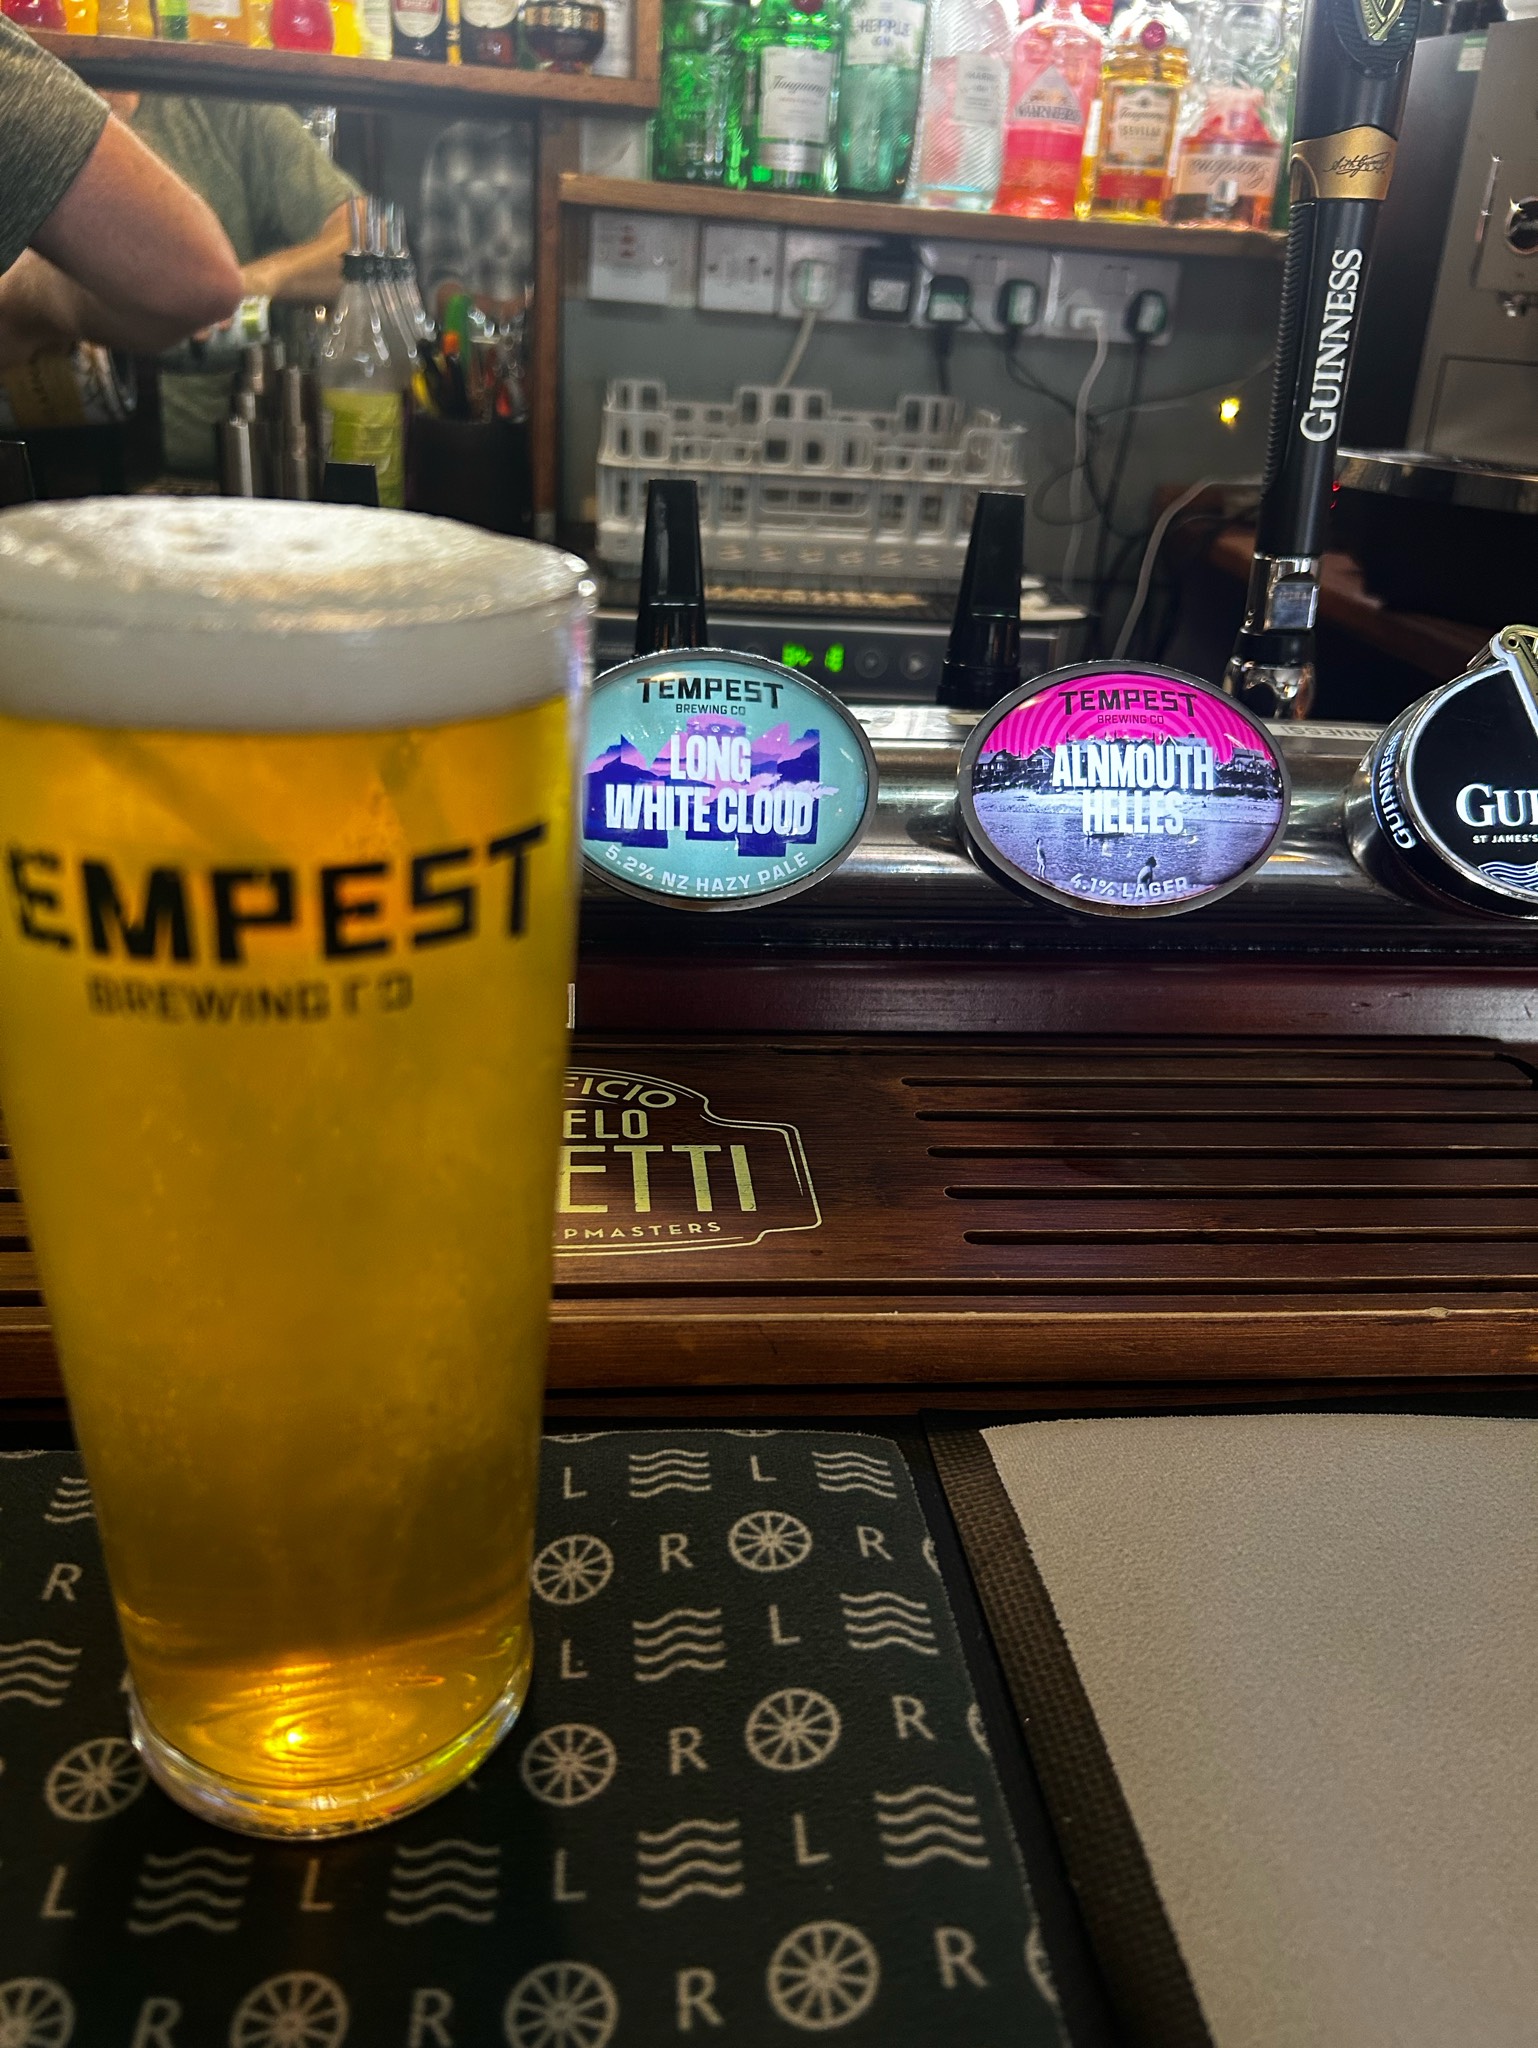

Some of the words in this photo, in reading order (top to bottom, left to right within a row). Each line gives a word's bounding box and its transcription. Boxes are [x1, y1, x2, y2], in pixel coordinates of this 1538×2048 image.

[1300, 248, 1363, 442] GUINNESS
[637, 677, 783, 709] TEMPEST
[675, 703, 728, 715] BREWING
[730, 706, 746, 716] CO
[1058, 689, 1197, 717] TEMPEST
[1097, 714, 1147, 725] BREWING
[1150, 716, 1165, 725] CO
[670, 735, 751, 782] LONG
[1052, 744, 1214, 790] ALNMOUTH
[605, 784, 710, 832] WHITE
[717, 788, 814, 835] CLOUD
[1082, 789, 1184, 835] HELLES
[1379, 731, 1417, 849] GUINNESS
[1472, 834, 1488, 844] ST
[605, 844, 654, 881] 5.2%
[661, 871, 690, 890] NZ
[696, 874, 751, 892] HAZY
[757, 852, 808, 886] PALE
[1121, 876, 1188, 898] LAGER
[88, 974, 331, 1024] BREWING
[563, 1109, 649, 1138] ELO
[557, 1145, 757, 1213] ETTI
[564, 1467, 586, 1499] L
[750, 1456, 776, 1481] L
[660, 1533, 693, 1572] R
[857, 1526, 892, 1560] R
[43, 1563, 81, 1601] R
[769, 1605, 800, 1645] L
[561, 1640, 587, 1679] L
[892, 1695, 934, 1739] R
[670, 1727, 707, 1774] R
[794, 1814, 829, 1865] L
[42, 1866, 72, 1918] L
[300, 1859, 333, 1911] L
[555, 1849, 586, 1901] L
[935, 1928, 986, 1987] R
[678, 1969, 721, 2030] R
